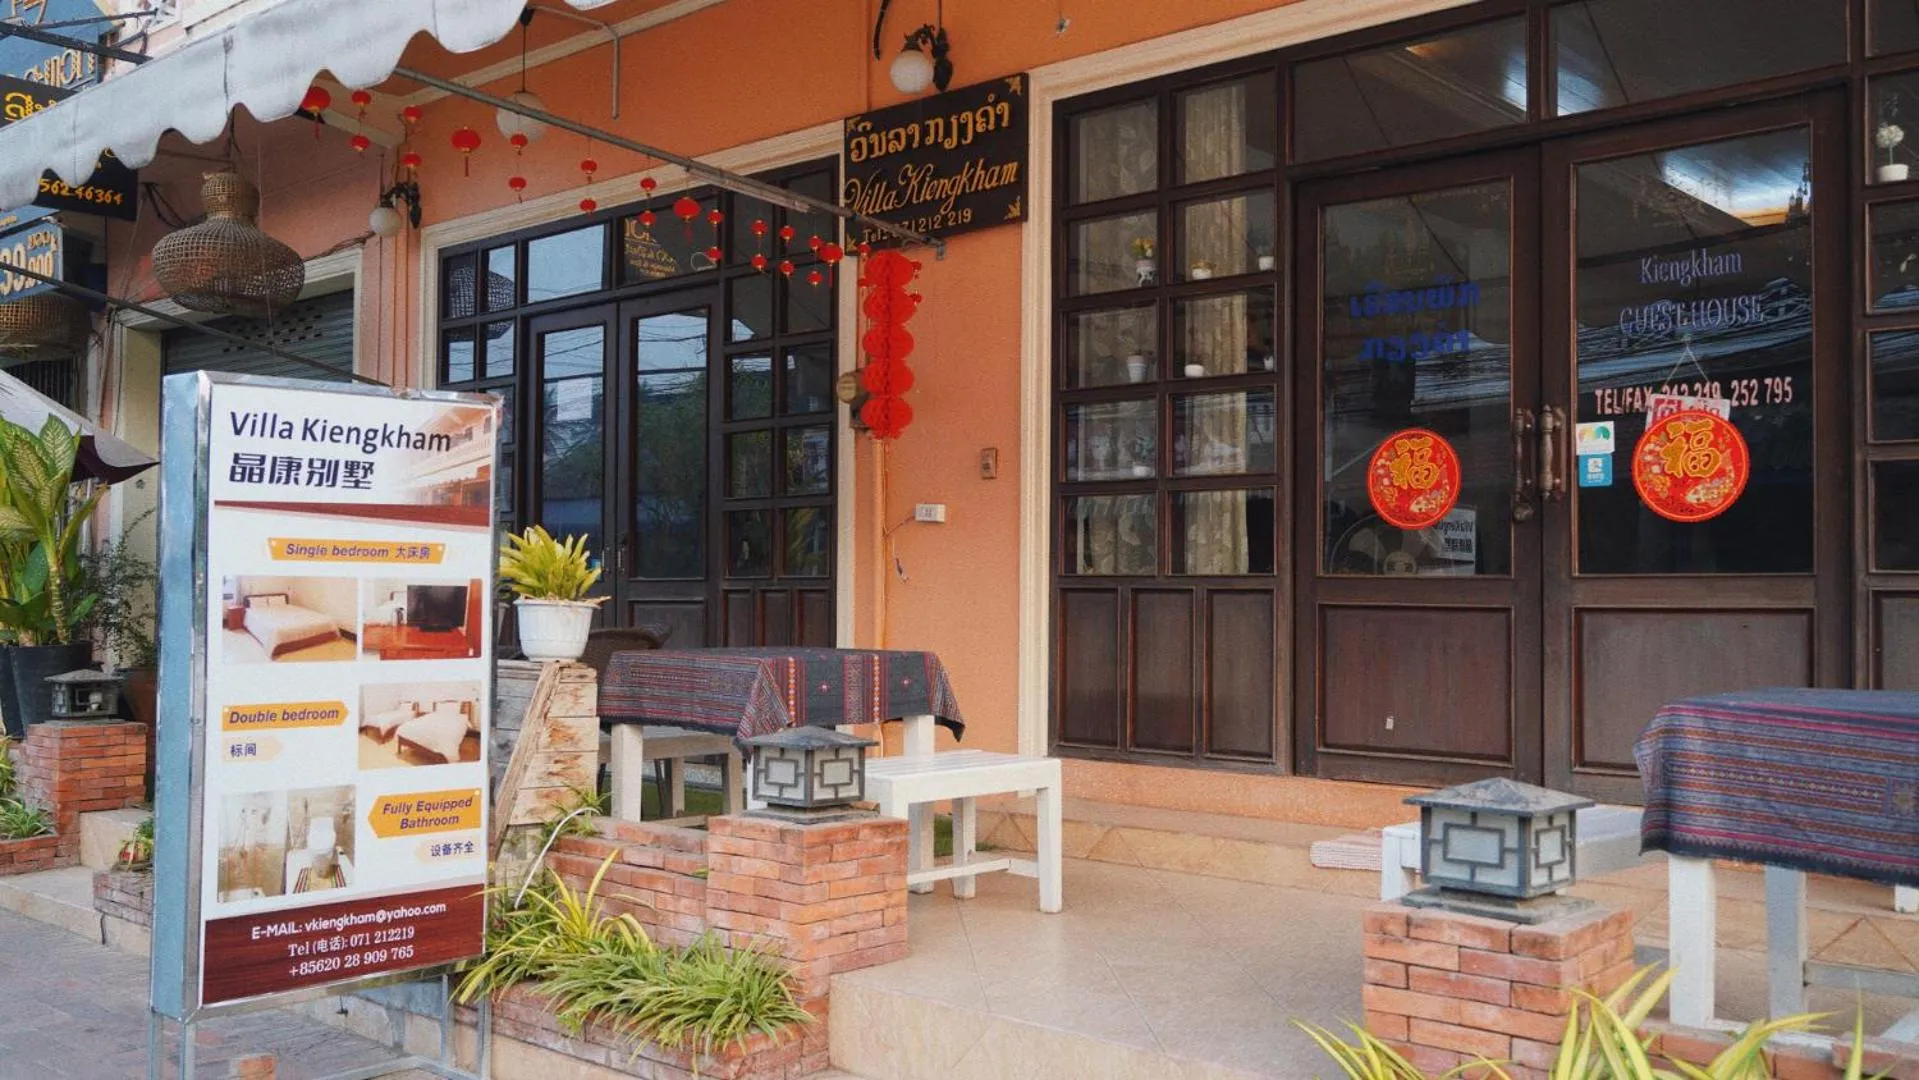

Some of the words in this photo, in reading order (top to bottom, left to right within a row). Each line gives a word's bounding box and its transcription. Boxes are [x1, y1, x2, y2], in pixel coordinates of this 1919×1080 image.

[844, 169, 897, 216] Villa
[896, 158, 1019, 215] Kiengkham
[918, 214, 942, 233] 212
[947, 207, 973, 227] 219
[1640, 248, 1742, 287] Kiengkham
[1730, 379, 1759, 407] 252
[1764, 376, 1793, 403] 795
[230, 411, 294, 440] Villa
[301, 417, 451, 454] Kiengkham
[1389, 437, 1440, 490] 福
[1660, 419, 1722, 479] 福
[229, 452, 375, 490] 晶康别墅
[286, 543, 328, 557] Single
[331, 544, 389, 557] bedroom
[229, 710, 277, 724] Double
[281, 708, 339, 721] bedroom
[230, 742, 257, 758] 标间
[383, 801, 413, 816] Fully
[416, 796, 473, 814] Equipped
[400, 815, 459, 830] Bathroom
[251, 922, 302, 940] E-MAIL:
[305, 903, 447, 932] vkiengkham@yahoo.com
[288, 942, 310, 957] Tel
[350, 932, 370, 948] 071
[374, 926, 416, 944] 212219
[288, 956, 341, 977] +85620
[343, 953, 360, 968] 28
[363, 950, 388, 966] 909
[391, 945, 414, 960] 765
